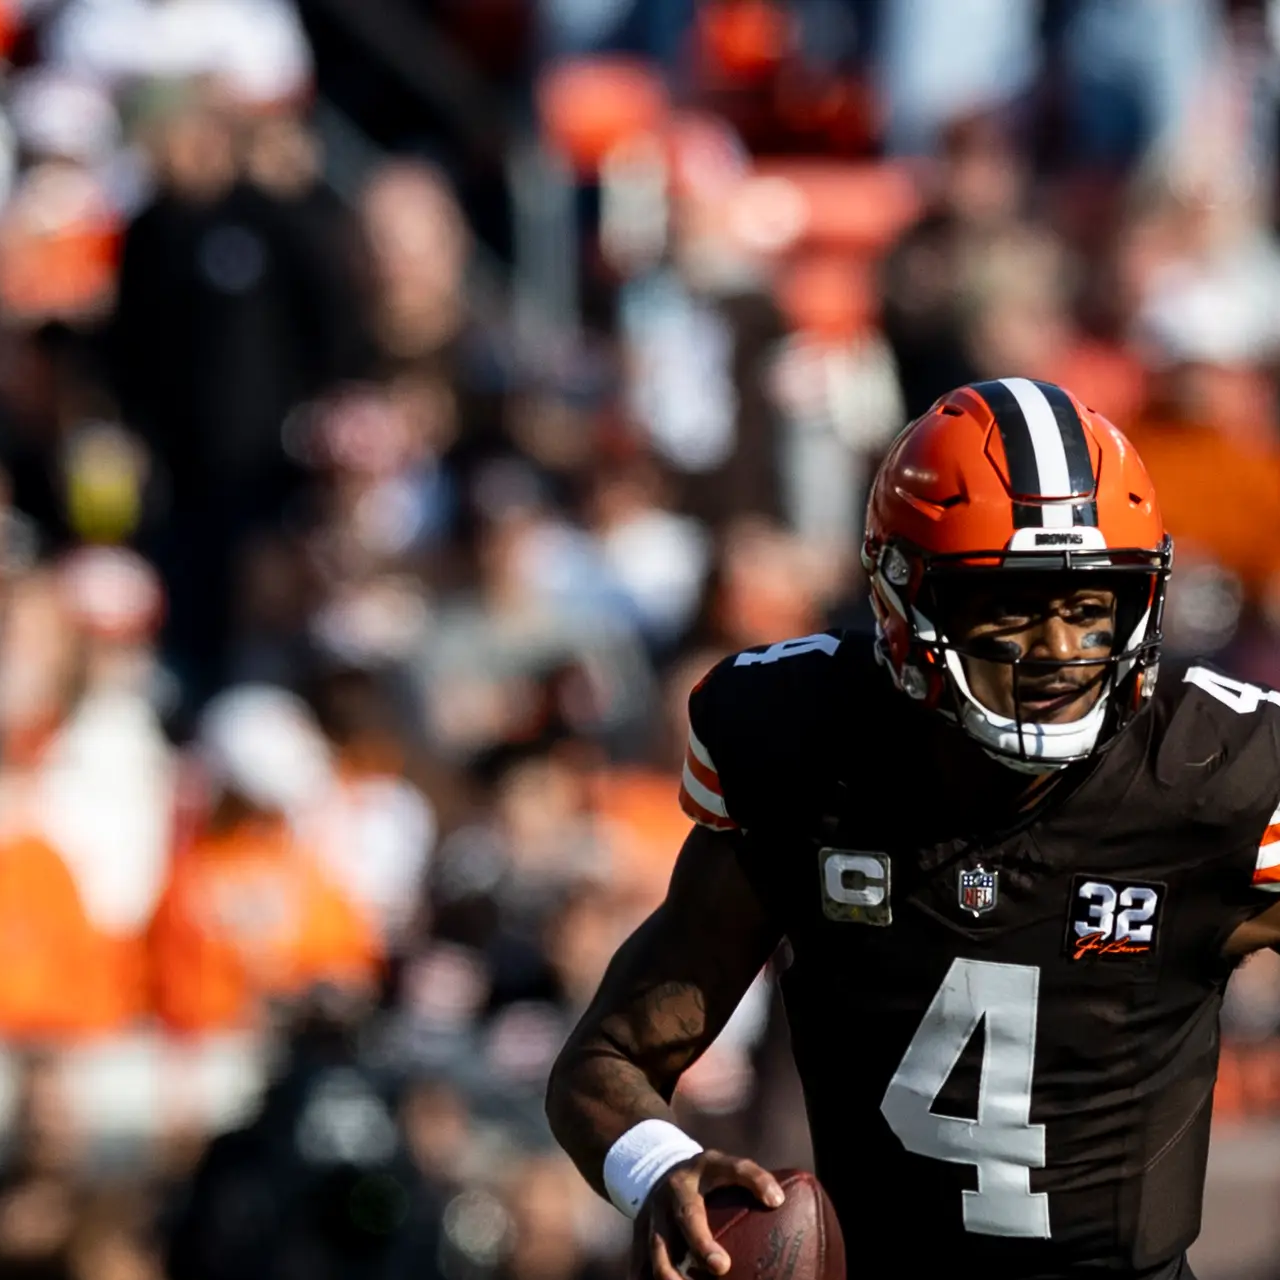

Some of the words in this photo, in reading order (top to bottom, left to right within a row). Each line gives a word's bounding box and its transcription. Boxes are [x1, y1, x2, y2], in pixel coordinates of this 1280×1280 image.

[1035, 533, 1083, 547] BROWNS
[733, 633, 841, 668] 4
[824, 854, 885, 907] C
[963, 887, 993, 907] NFL
[1074, 881, 1158, 941] 32
[880, 957, 1052, 1239] 4
